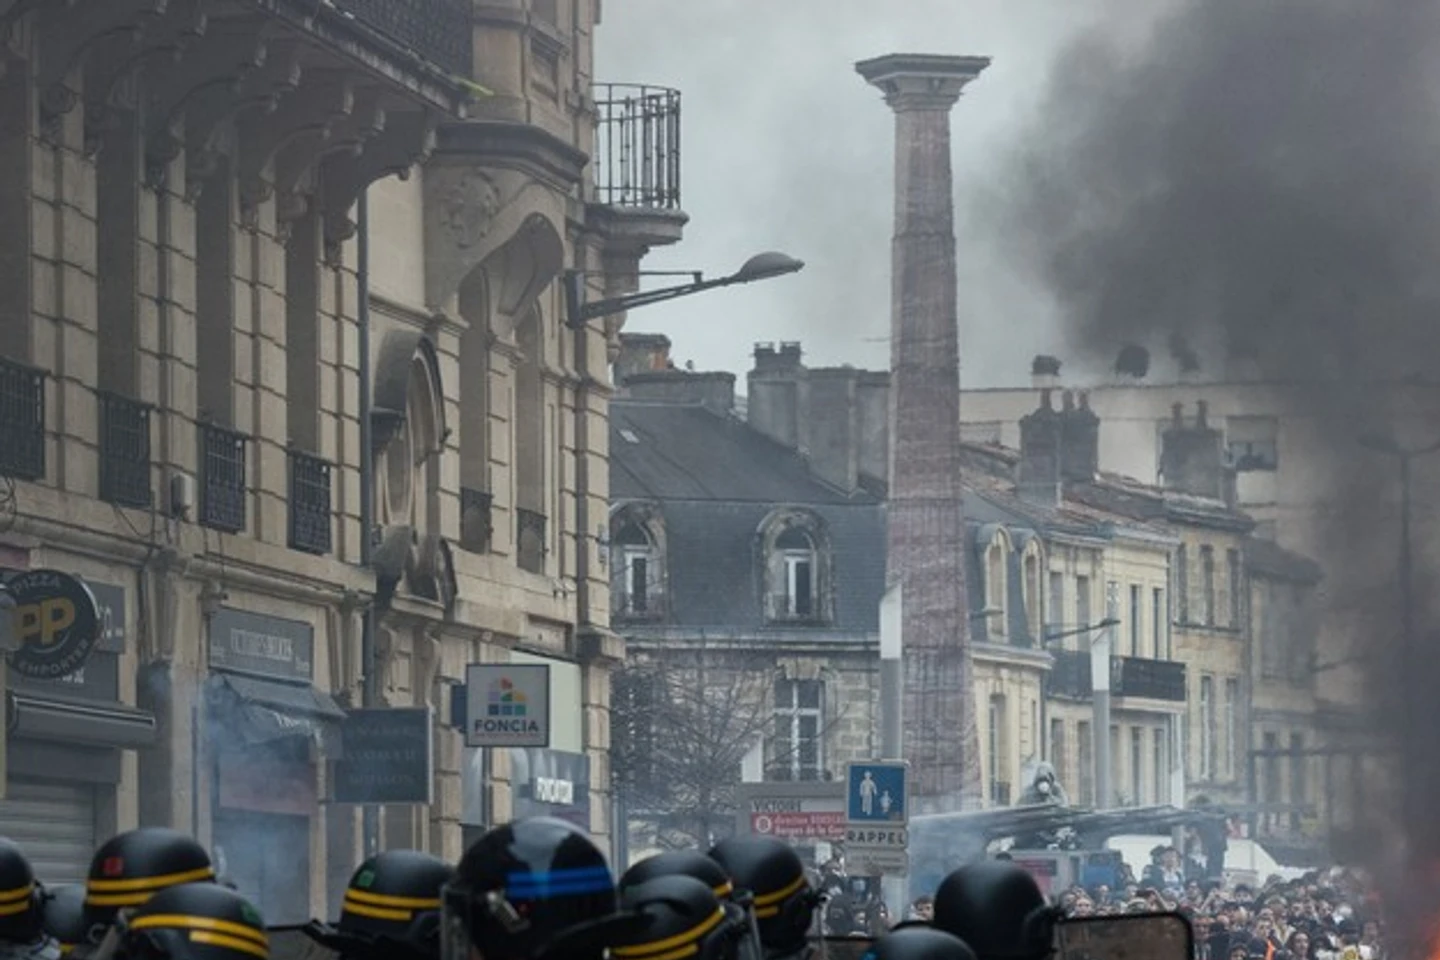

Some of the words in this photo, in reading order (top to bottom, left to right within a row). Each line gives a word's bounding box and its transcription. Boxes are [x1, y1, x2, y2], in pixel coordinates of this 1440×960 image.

[11, 573, 61, 595] PIZZA
[18, 638, 88, 675] EMPORTER
[474, 719, 540, 733] FONCIA
[848, 831, 906, 844] RAPPEL
